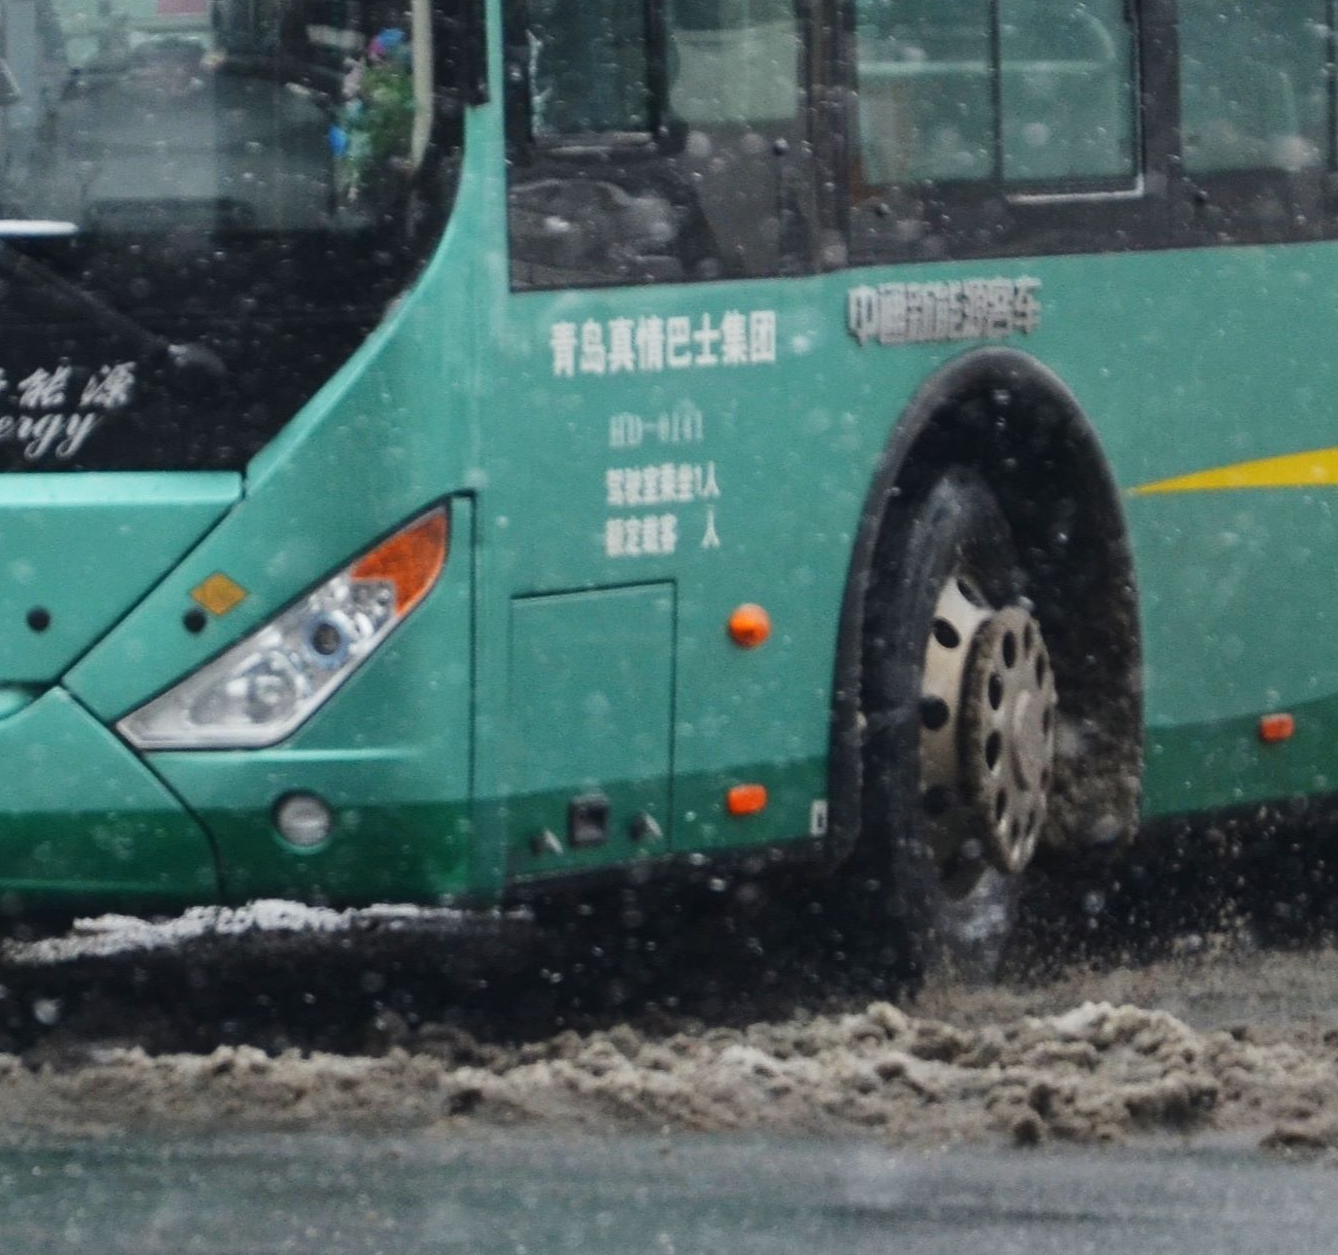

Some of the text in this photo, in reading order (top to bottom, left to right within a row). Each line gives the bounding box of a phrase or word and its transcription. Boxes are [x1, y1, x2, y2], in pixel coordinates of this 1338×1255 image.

[550, 309, 777, 378] 青岛真情巴士集团
